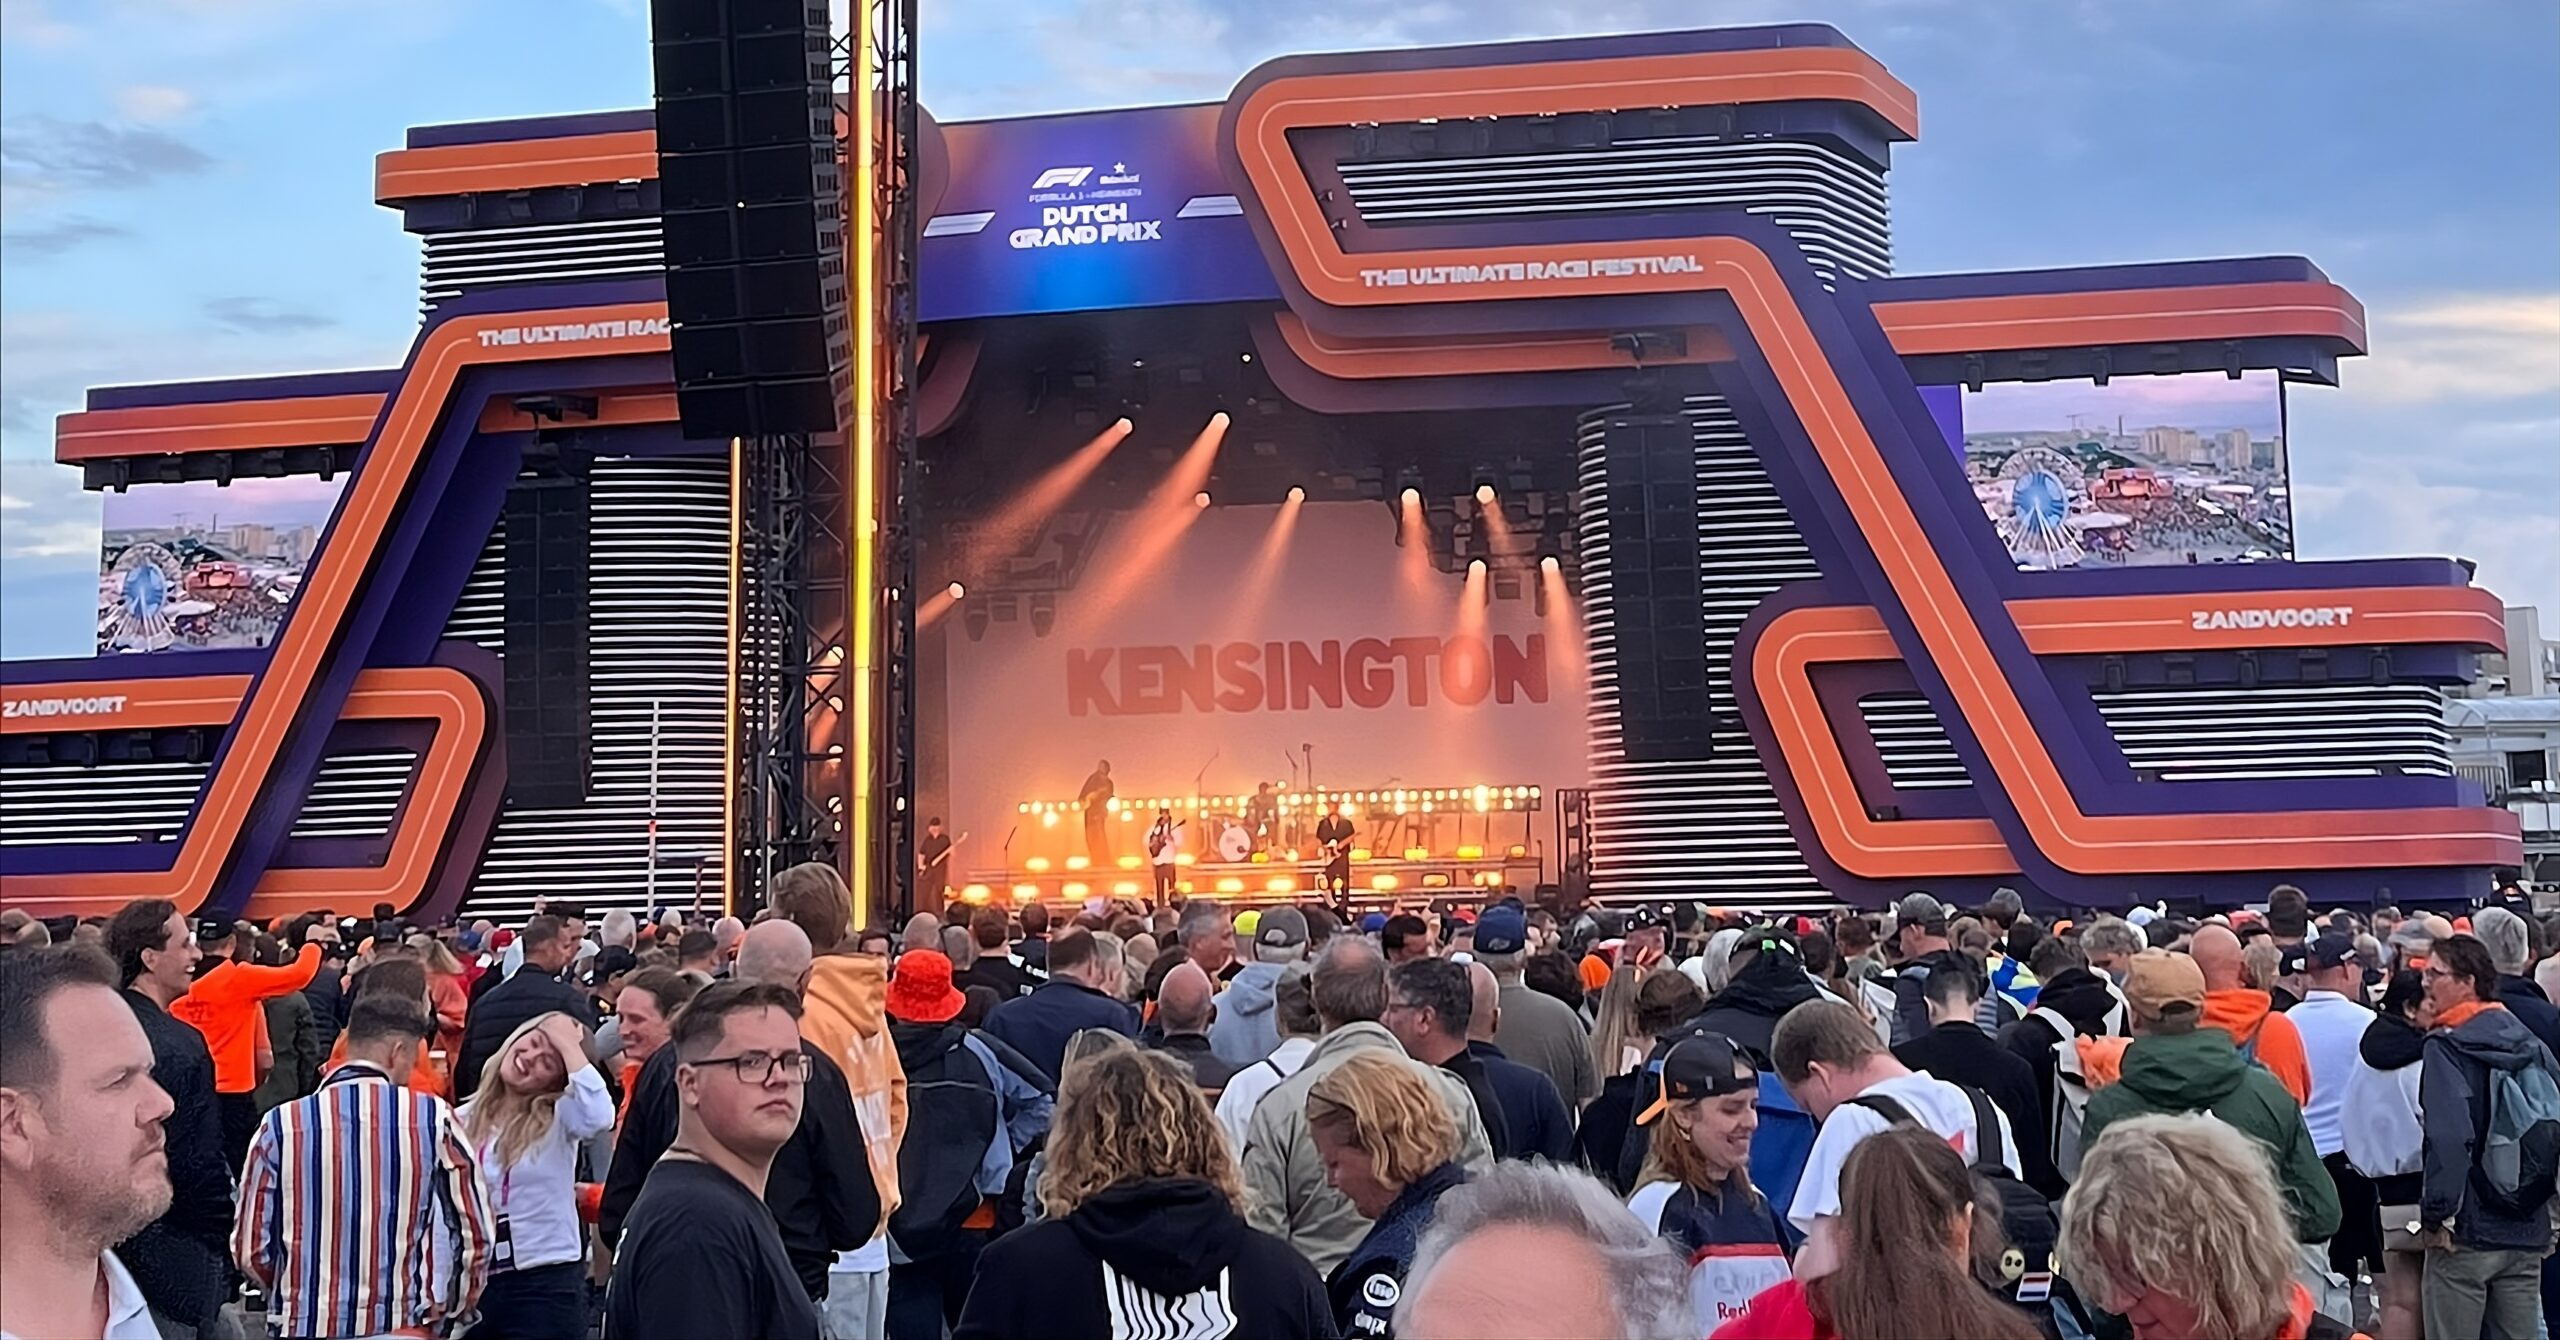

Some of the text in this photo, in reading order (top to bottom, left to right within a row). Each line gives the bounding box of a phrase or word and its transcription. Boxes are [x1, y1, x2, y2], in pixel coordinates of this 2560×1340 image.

[1043, 202, 1128, 226] DUTCH
[1009, 220, 1161, 249] GRAND PRIX
[1360, 255, 1704, 287] THE ULTIMATE RACE FESTIVAL
[477, 317, 673, 347] THE ULTIMATE RAC
[2192, 607, 2353, 630] ZANDVOORT
[1066, 633, 1549, 717] KENSINGTON
[2, 695, 127, 718] ZANDVOORT
[1717, 1298, 1752, 1320] Red
